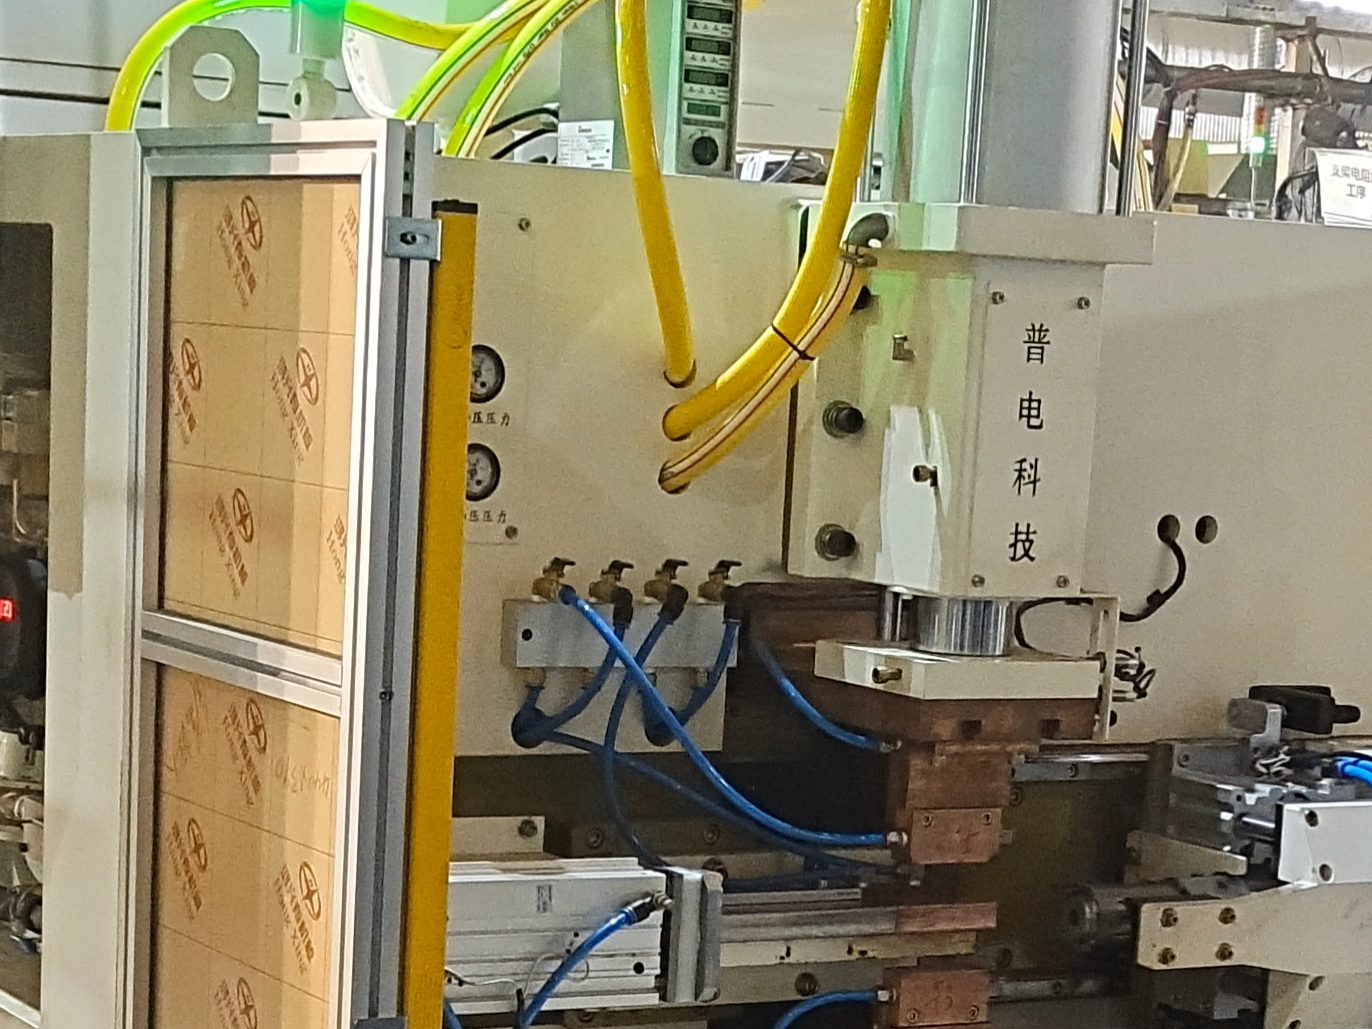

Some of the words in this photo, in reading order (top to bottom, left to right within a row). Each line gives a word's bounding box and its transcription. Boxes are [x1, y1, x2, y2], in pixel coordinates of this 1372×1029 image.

[1346, 183, 1366, 199] 工序
[468, 411, 510, 426] 压压力
[1008, 322, 1051, 562] 普电科技
[464, 509, 507, 524] 压压力
